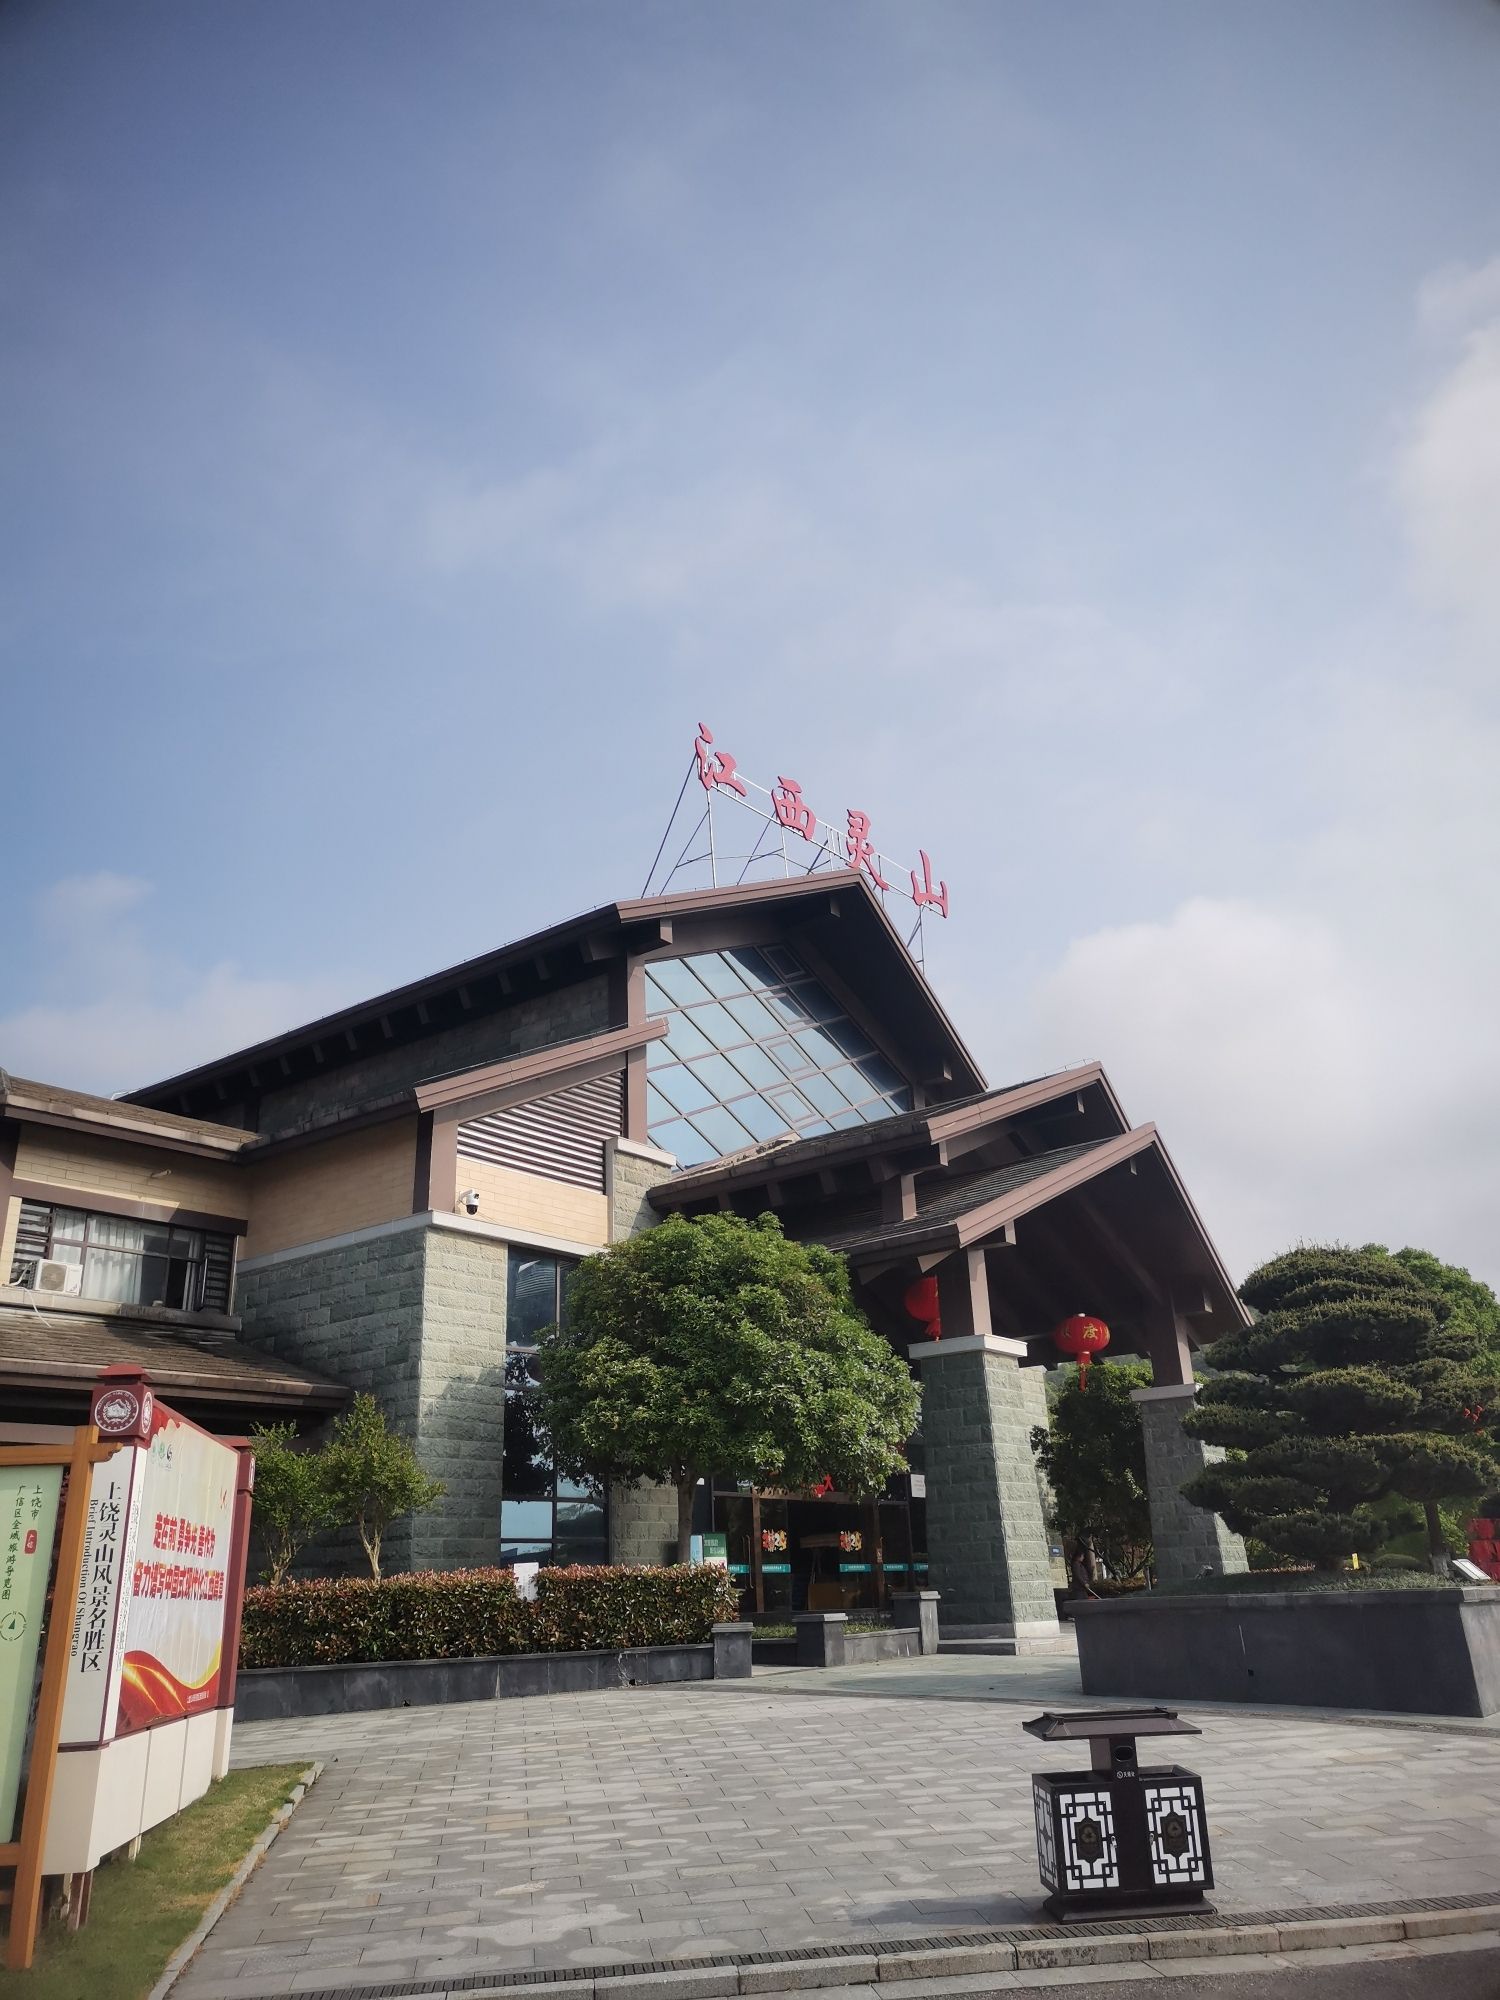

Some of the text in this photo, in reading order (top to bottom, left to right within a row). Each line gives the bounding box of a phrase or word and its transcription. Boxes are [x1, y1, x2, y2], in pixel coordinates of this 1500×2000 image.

[694, 722, 949, 919] 江西灵山
[30, 1484, 43, 1520] 上饶市
[70, 1499, 99, 1657] Brief Introduction Of Shangrao
[80, 1481, 121, 1673] 上饶灵山风景名胜区
